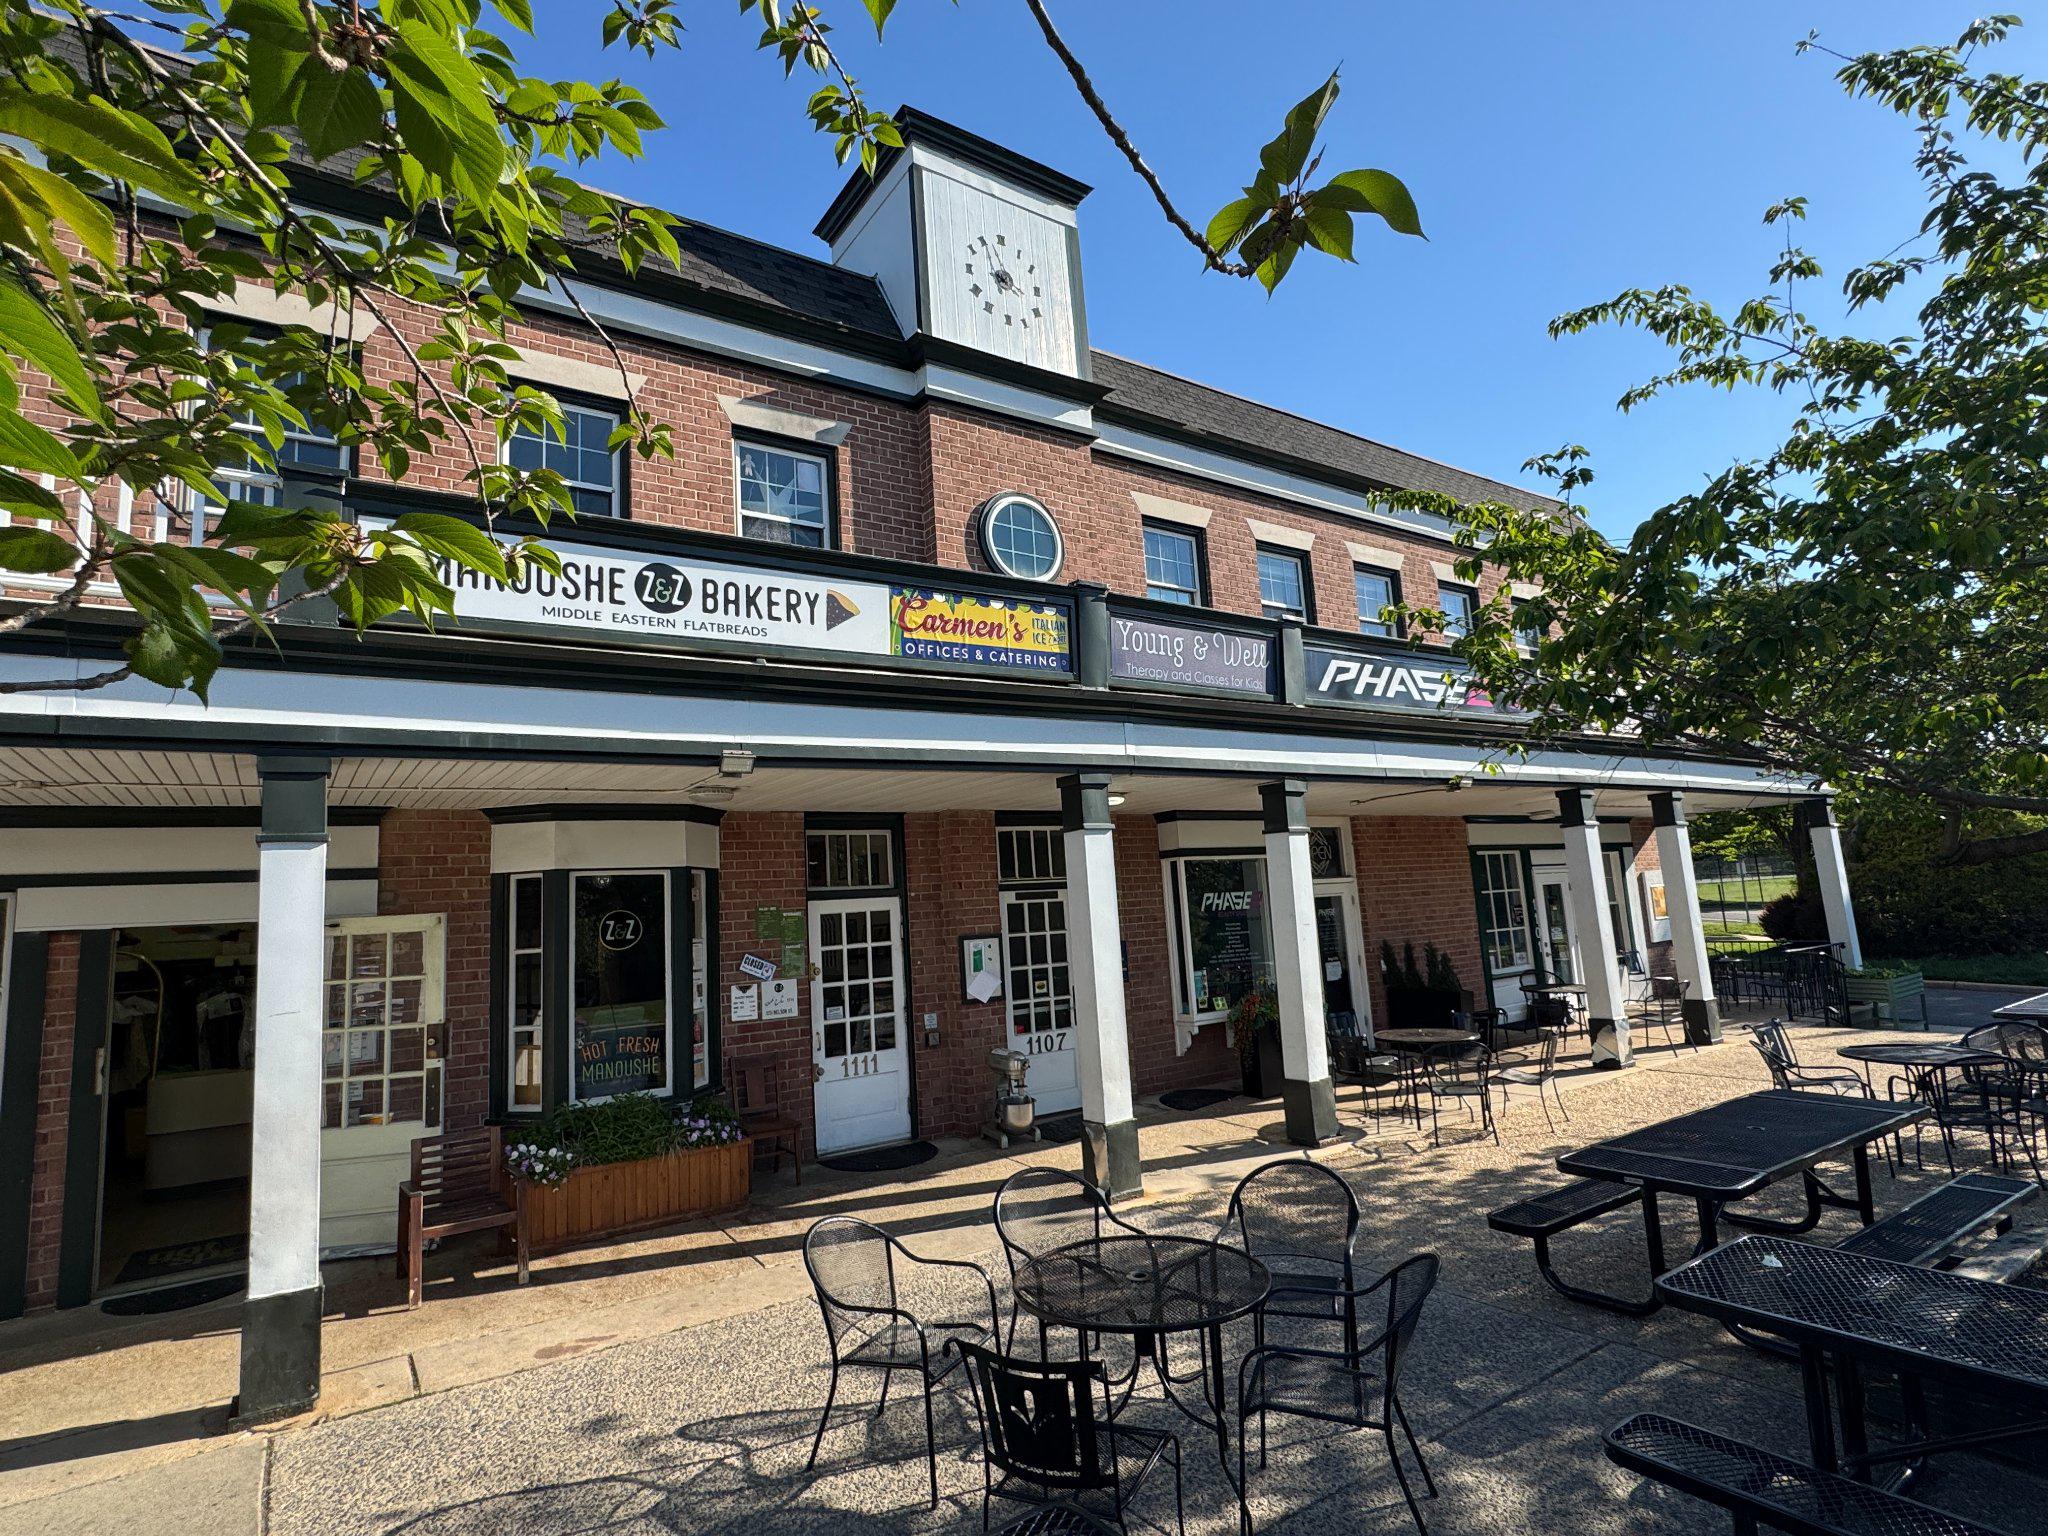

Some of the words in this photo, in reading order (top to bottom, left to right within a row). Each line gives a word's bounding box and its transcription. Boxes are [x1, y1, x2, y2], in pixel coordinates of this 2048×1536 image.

[641, 570, 685, 606] Z&Z
[701, 578, 820, 626] BAKERY
[542, 606, 602, 621] MIDDLE
[611, 612, 676, 629] EASTERN
[683, 620, 768, 637] FLATBREADS
[898, 596, 1028, 643] Carmen's
[1032, 617, 1066, 632] ITALIAN
[1033, 632, 1047, 645] ICE
[1116, 620, 1184, 668] Young
[1193, 635, 1209, 661] &
[1213, 632, 1270, 669] Well
[905, 643, 969, 659] OFFICES
[975, 650, 984, 660] &
[989, 651, 1057, 667] CATERING
[1126, 662, 1169, 681] Therapy
[1171, 670, 1192, 682] and
[1194, 671, 1229, 686] Classes
[1231, 675, 1244, 687] for
[1246, 678, 1264, 690] Kids
[1201, 890, 1253, 912] PHASE
[605, 919, 635, 941] Z&Z
[581, 1040, 607, 1062] HOT
[618, 1036, 660, 1054] FRESH
[1026, 1032, 1067, 1055] 1107
[582, 1056, 660, 1085] MANOUSHE
[841, 1053, 879, 1077] 1111
